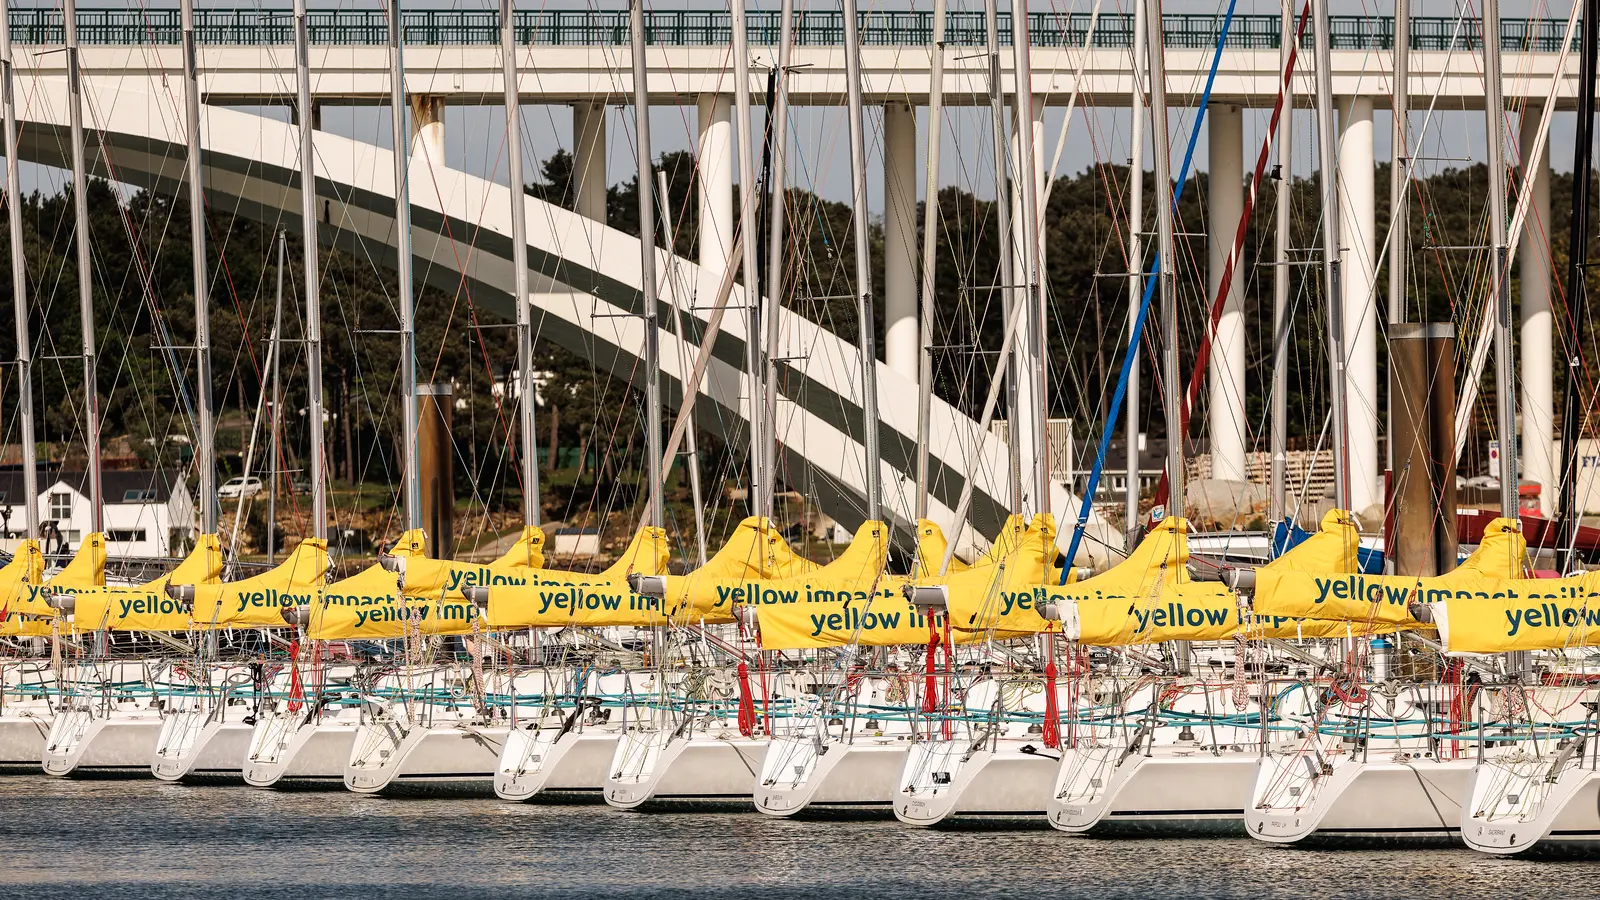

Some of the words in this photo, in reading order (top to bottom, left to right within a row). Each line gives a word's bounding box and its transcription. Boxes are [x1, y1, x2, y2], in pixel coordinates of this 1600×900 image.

[238, 589, 311, 613] yellow
[538, 588, 622, 614] yellow
[714, 584, 798, 607] yellow
[1314, 575, 1409, 604] yellow
[811, 608, 901, 636] yellow
[1133, 602, 1228, 633] yellow
